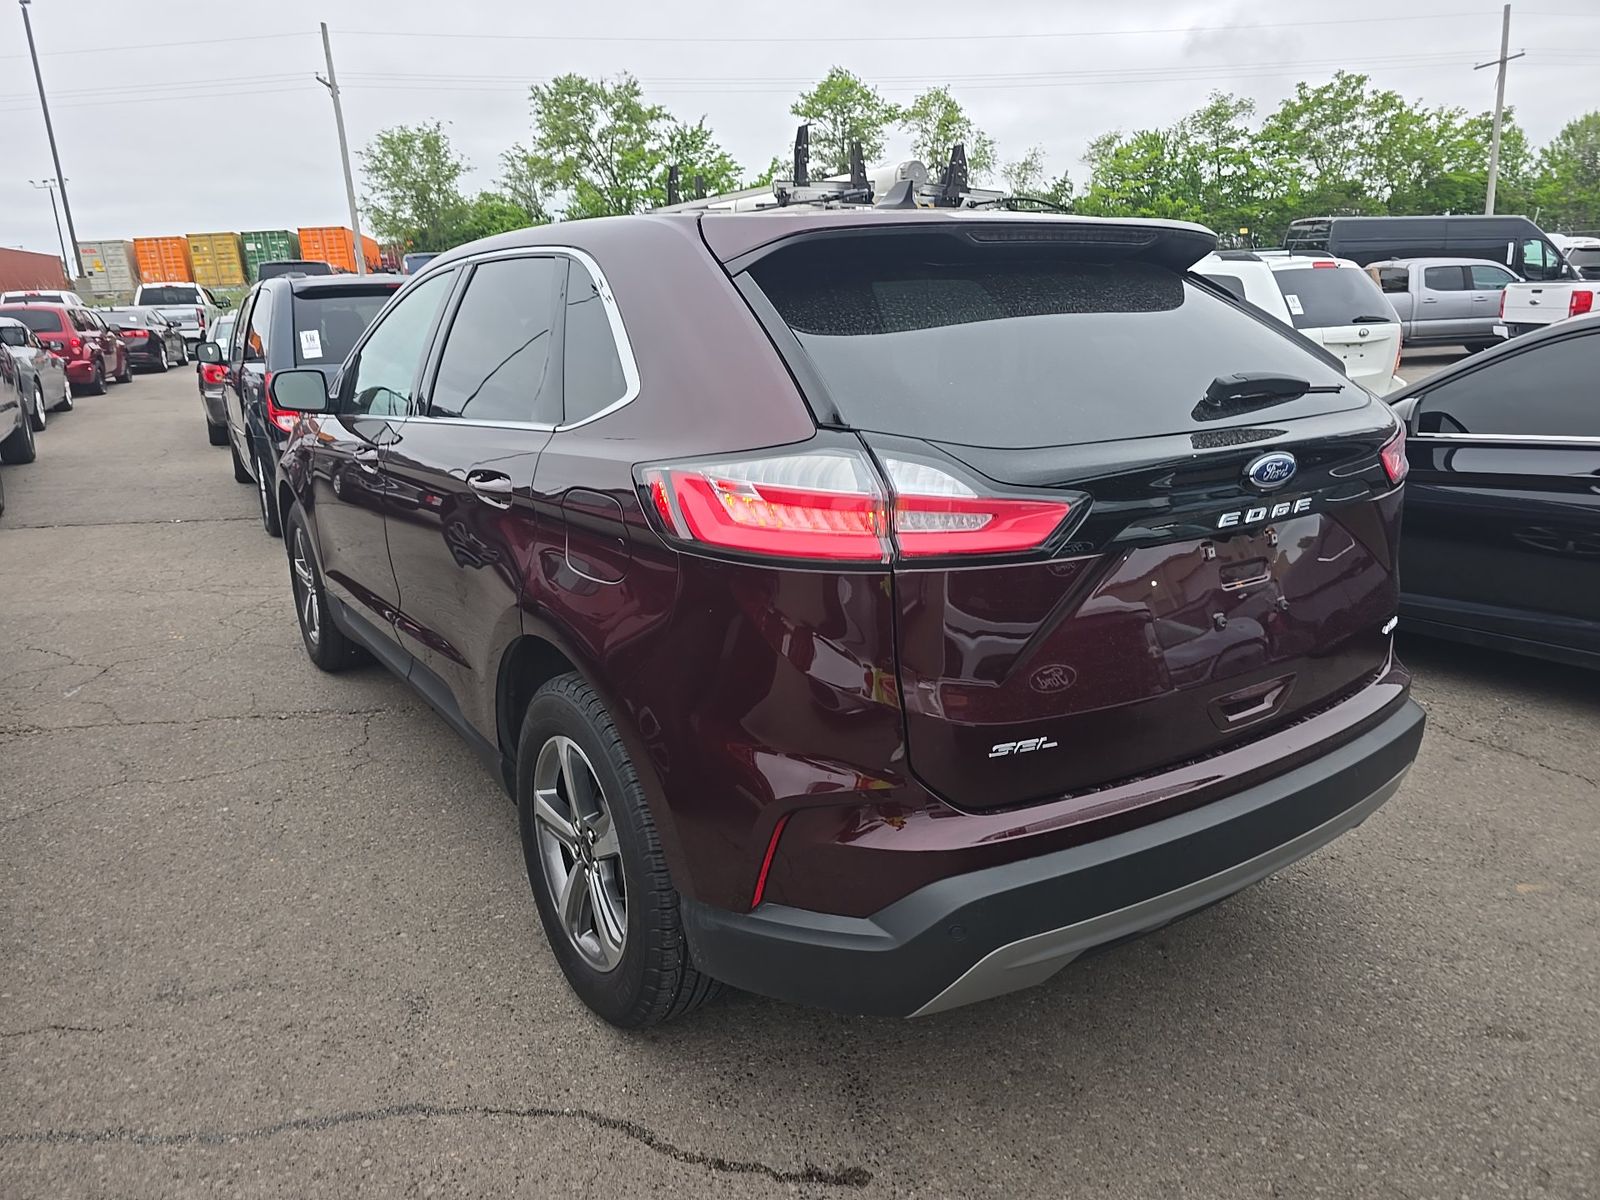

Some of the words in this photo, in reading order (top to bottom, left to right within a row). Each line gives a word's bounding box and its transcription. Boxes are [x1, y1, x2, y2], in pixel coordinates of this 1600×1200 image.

[1262, 461, 1289, 481] Ford
[1218, 497, 1313, 528] EDGE
[988, 736, 1058, 758] SEL
